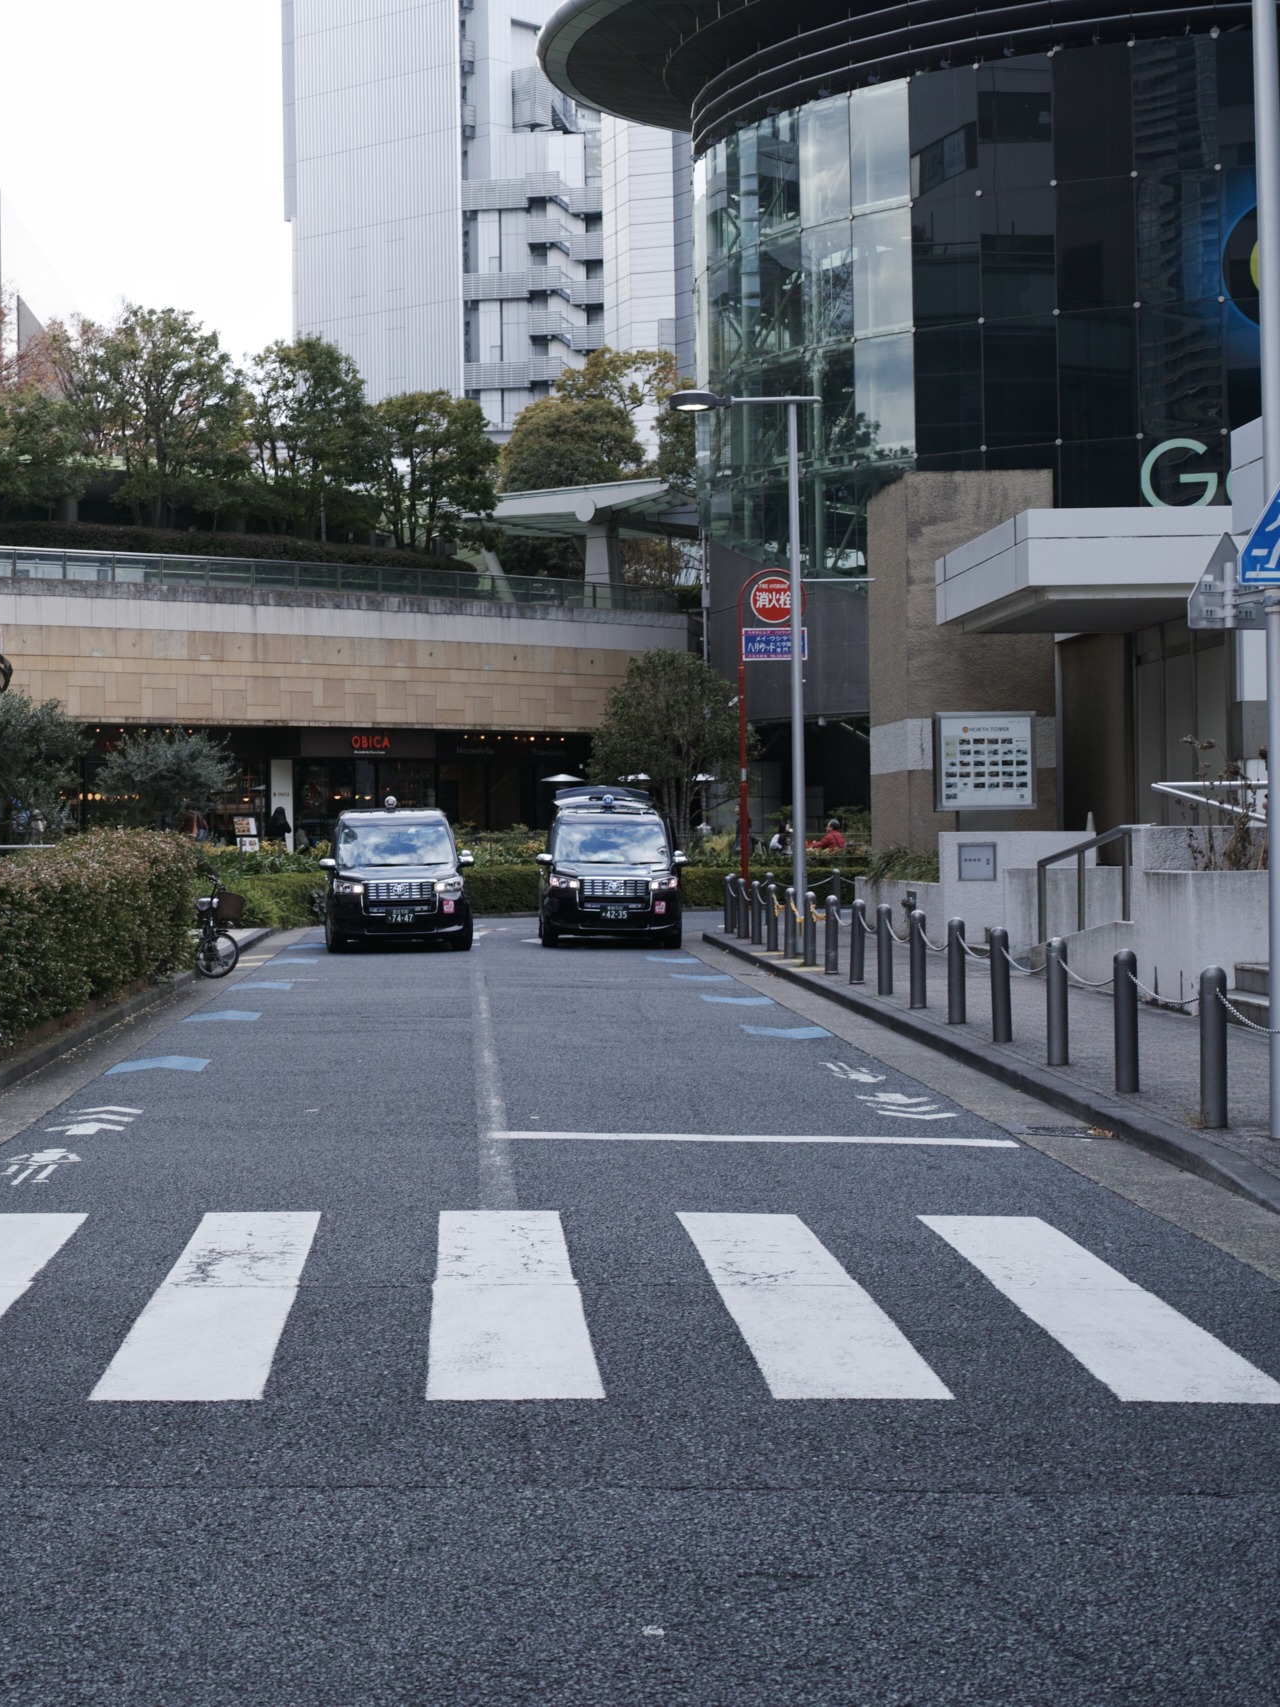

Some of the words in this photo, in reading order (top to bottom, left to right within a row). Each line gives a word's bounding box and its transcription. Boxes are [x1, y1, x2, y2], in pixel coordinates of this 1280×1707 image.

[1141, 438, 1232, 507] G
[756, 591, 791, 608] 消火栓
[747, 642, 775, 652] ハリウッド
